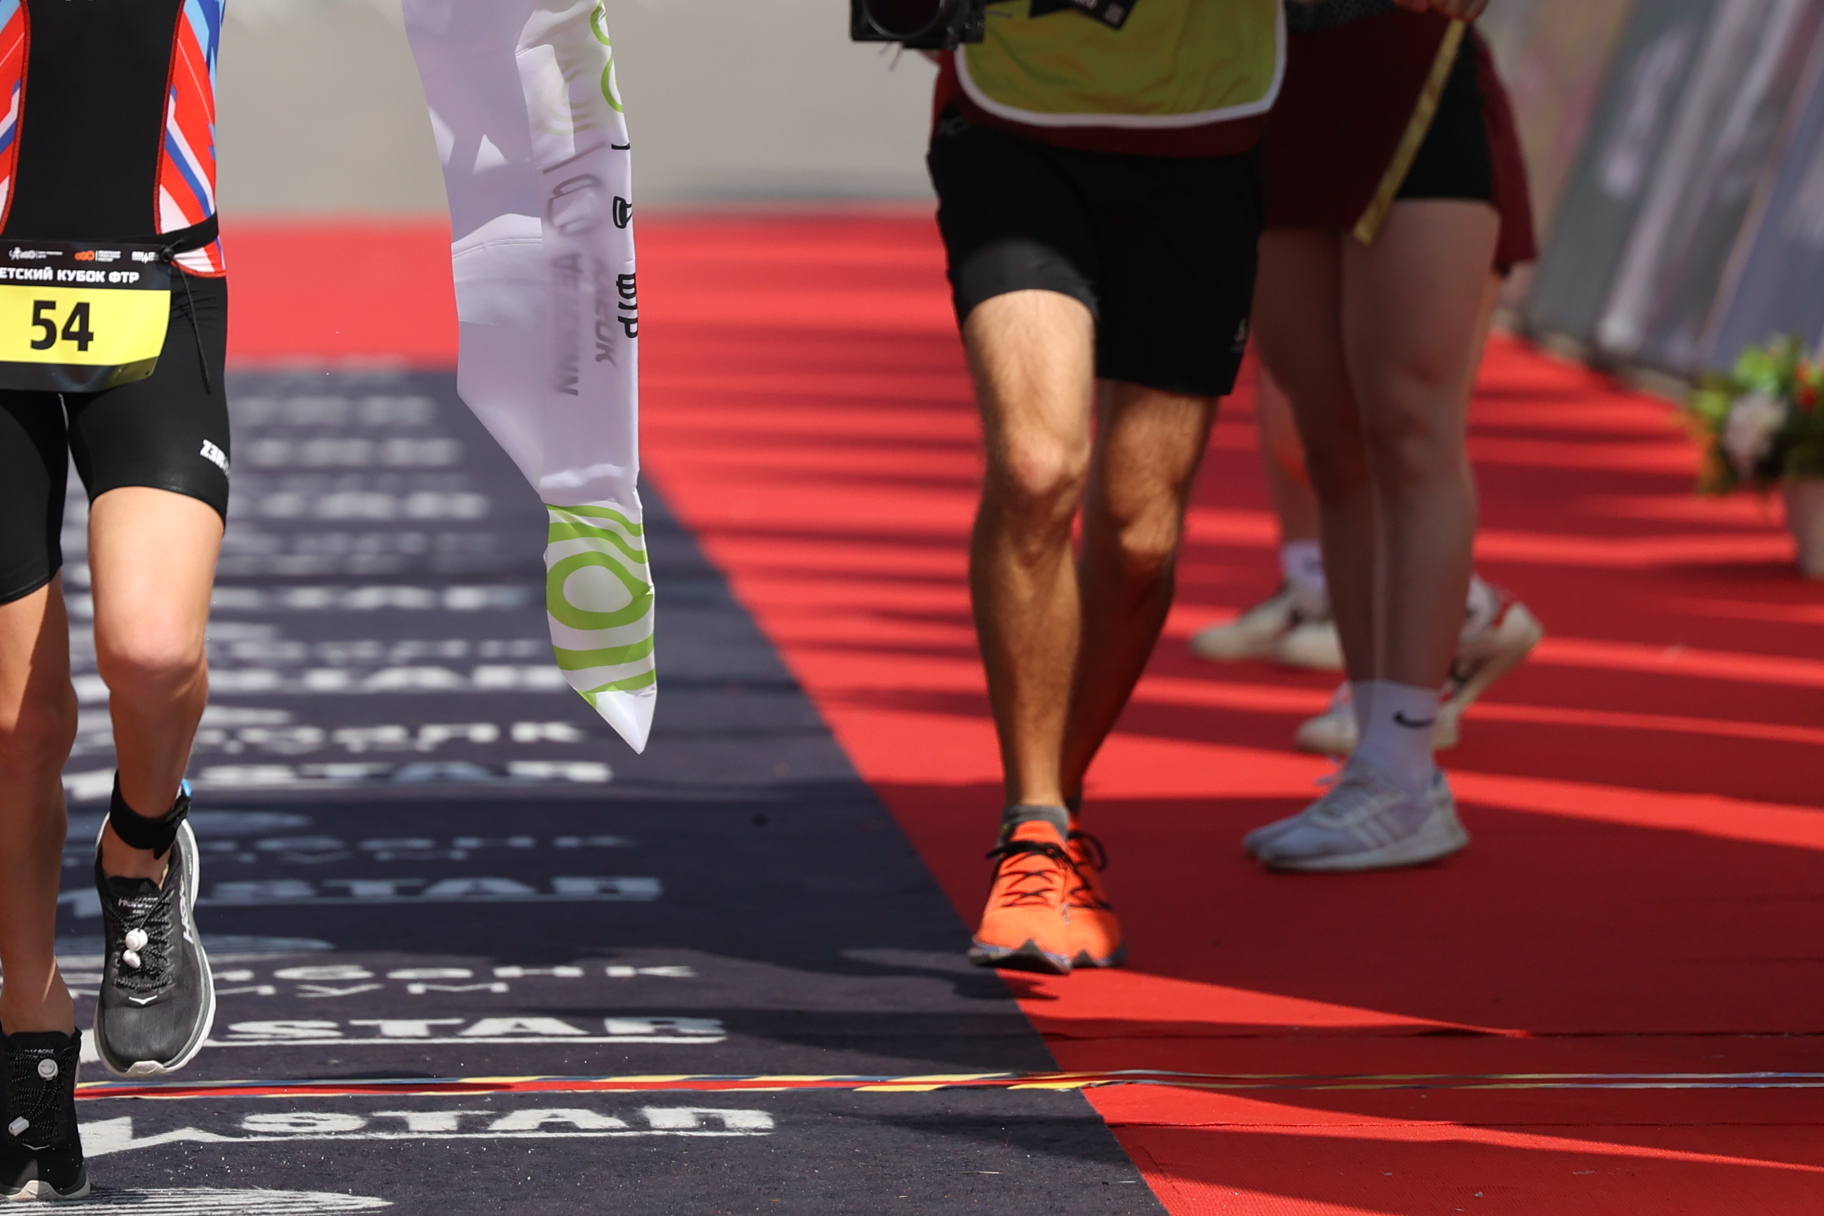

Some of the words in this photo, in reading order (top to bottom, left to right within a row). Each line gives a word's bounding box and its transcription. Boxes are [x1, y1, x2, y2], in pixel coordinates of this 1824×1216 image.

[57, 269, 106, 283] КУБОК
[108, 270, 140, 284] ФТР
[30, 299, 95, 352] 54
[227, 1017, 726, 1038] STAR
[241, 1107, 775, 1133] STAR
